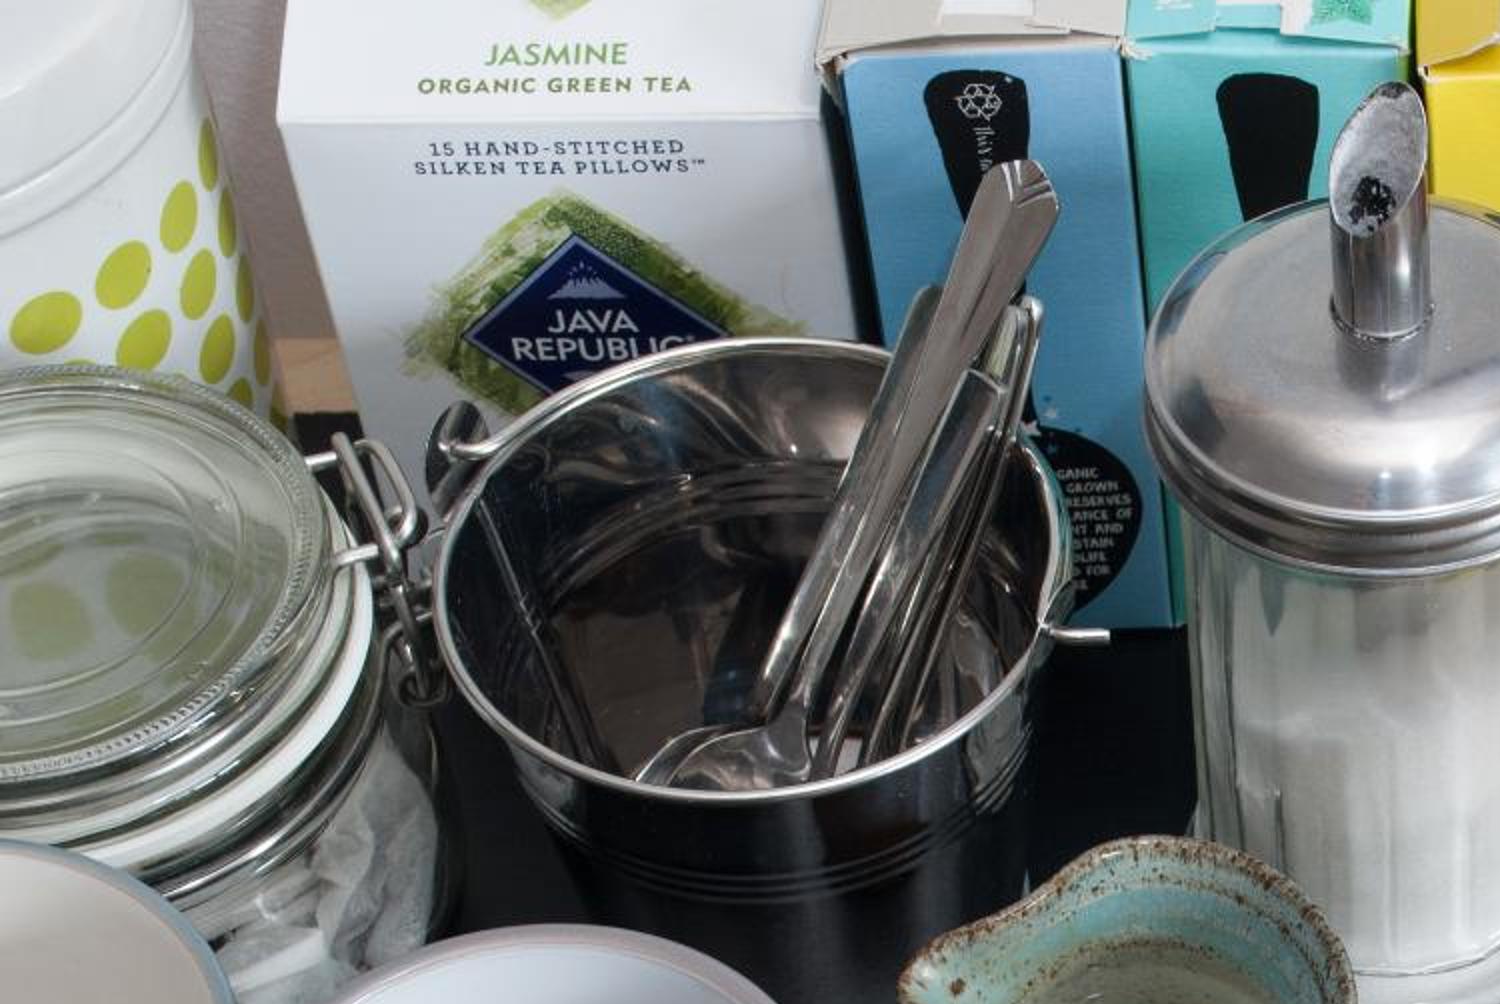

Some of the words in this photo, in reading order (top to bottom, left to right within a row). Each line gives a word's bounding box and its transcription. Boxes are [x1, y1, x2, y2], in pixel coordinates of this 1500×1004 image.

[484, 42, 629, 67] JASMINE
[417, 77, 537, 95] ORGANIC
[547, 76, 632, 94] GREEN
[643, 76, 693, 93] TEA
[429, 142, 455, 157] 15
[464, 139, 685, 157] HAND-STITCHED
[415, 160, 506, 176] SILKEN
[515, 160, 566, 175] TEA
[547, 308, 640, 334] JAVA
[1056, 467, 1100, 481] GANIC
